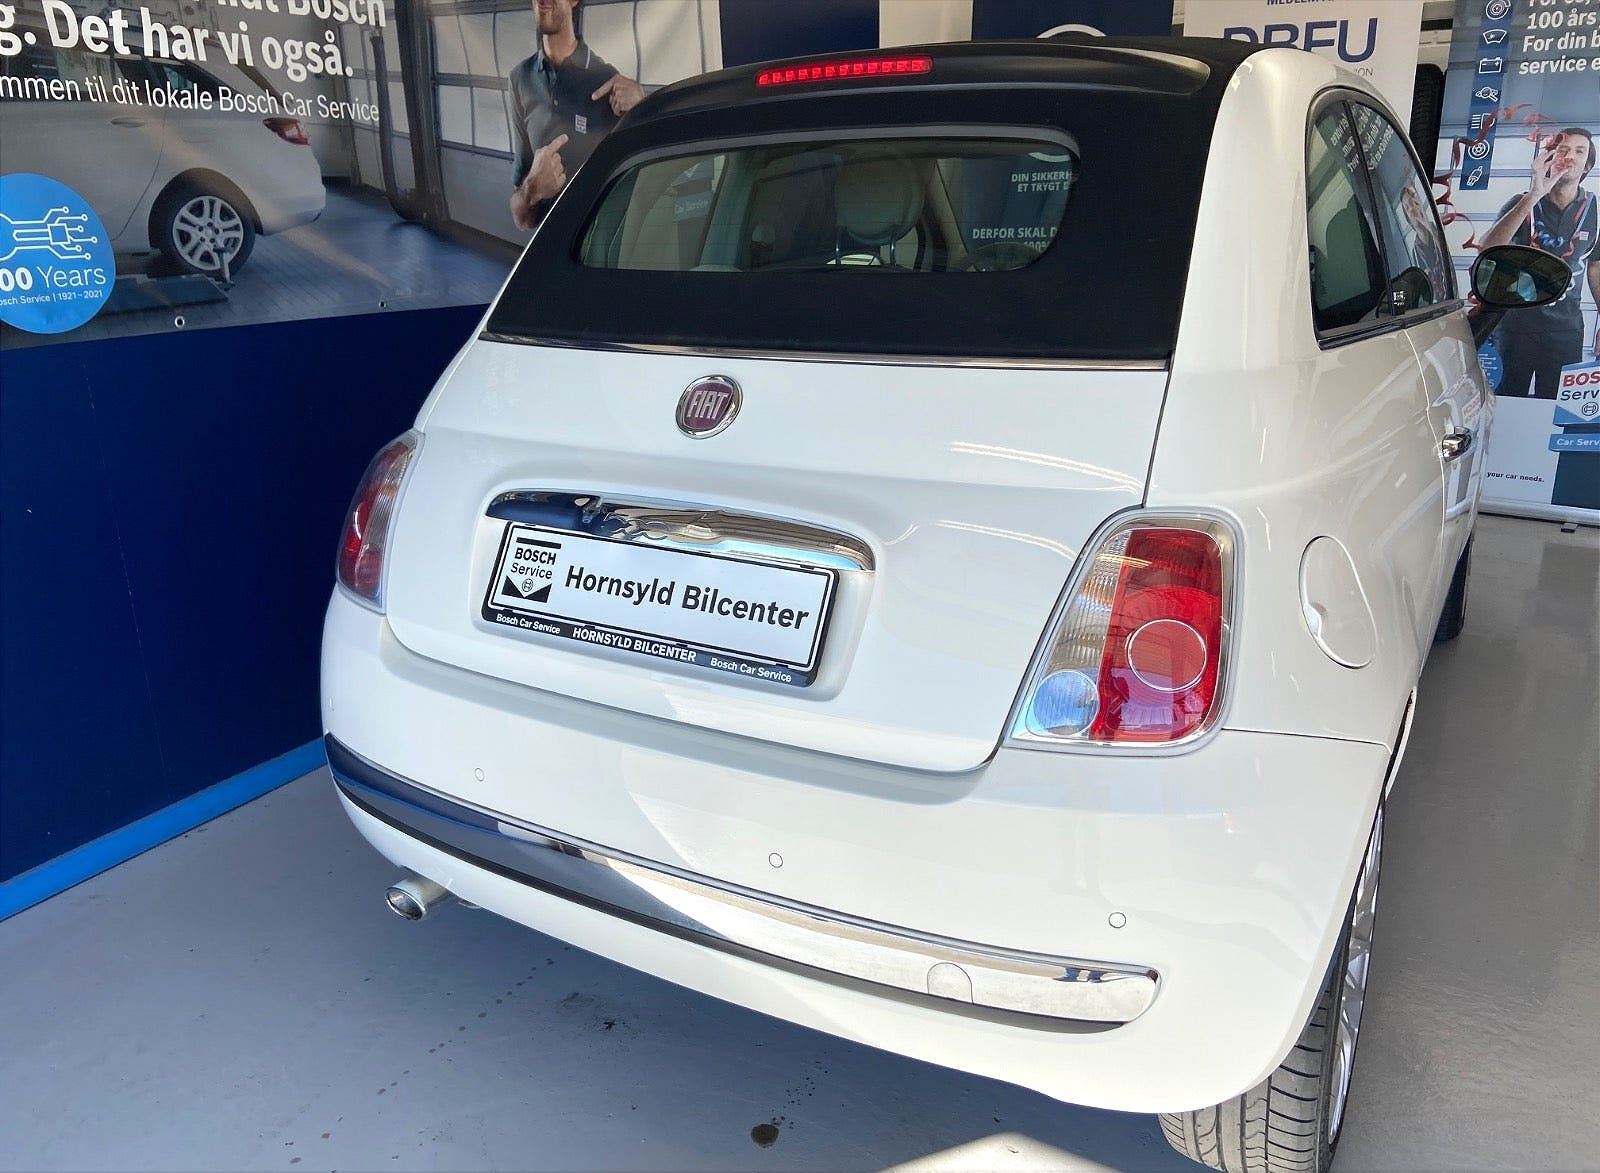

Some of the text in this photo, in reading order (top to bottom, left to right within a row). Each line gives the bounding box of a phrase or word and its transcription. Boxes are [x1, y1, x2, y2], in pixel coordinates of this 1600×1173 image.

[1527, 8, 1597, 30] 100 års
[42, 0, 131, 55] Det
[140, 6, 208, 62] har
[215, 20, 254, 67] vi
[261, 29, 354, 82] også.
[1523, 35, 1554, 52] For
[1557, 31, 1587, 50] din
[1519, 55, 1587, 75] service
[85, 75, 108, 103] til
[112, 77, 143, 106] dit
[145, 79, 213, 110] lokale
[218, 86, 279, 115] Bosch
[282, 91, 313, 118] Car
[318, 94, 380, 121] Service
[1011, 173, 1029, 182] DIN
[1017, 183, 1029, 192] ET
[1031, 182, 1061, 191] TRYGT
[972, 228, 1015, 239] DERFOR
[1017, 227, 1047, 238] SKAL
[36, 265, 107, 288] Years
[19, 294, 51, 304] Service
[57, 291, 77, 300] 1921
[83, 289, 103, 299] 2021
[686, 390, 730, 420] FIAT
[1556, 438, 1575, 446] Car
[1519, 475, 1545, 483] needs.
[514, 547, 557, 566] BOSCH
[510, 562, 553, 580] Service
[565, 565, 810, 630] Hornsyld Bilcenter
[496, 613, 561, 634] Bosch Car Service
[572, 627, 697, 662] HORNSYLD BILCENTER
[710, 657, 792, 683] Bosch Car Service
